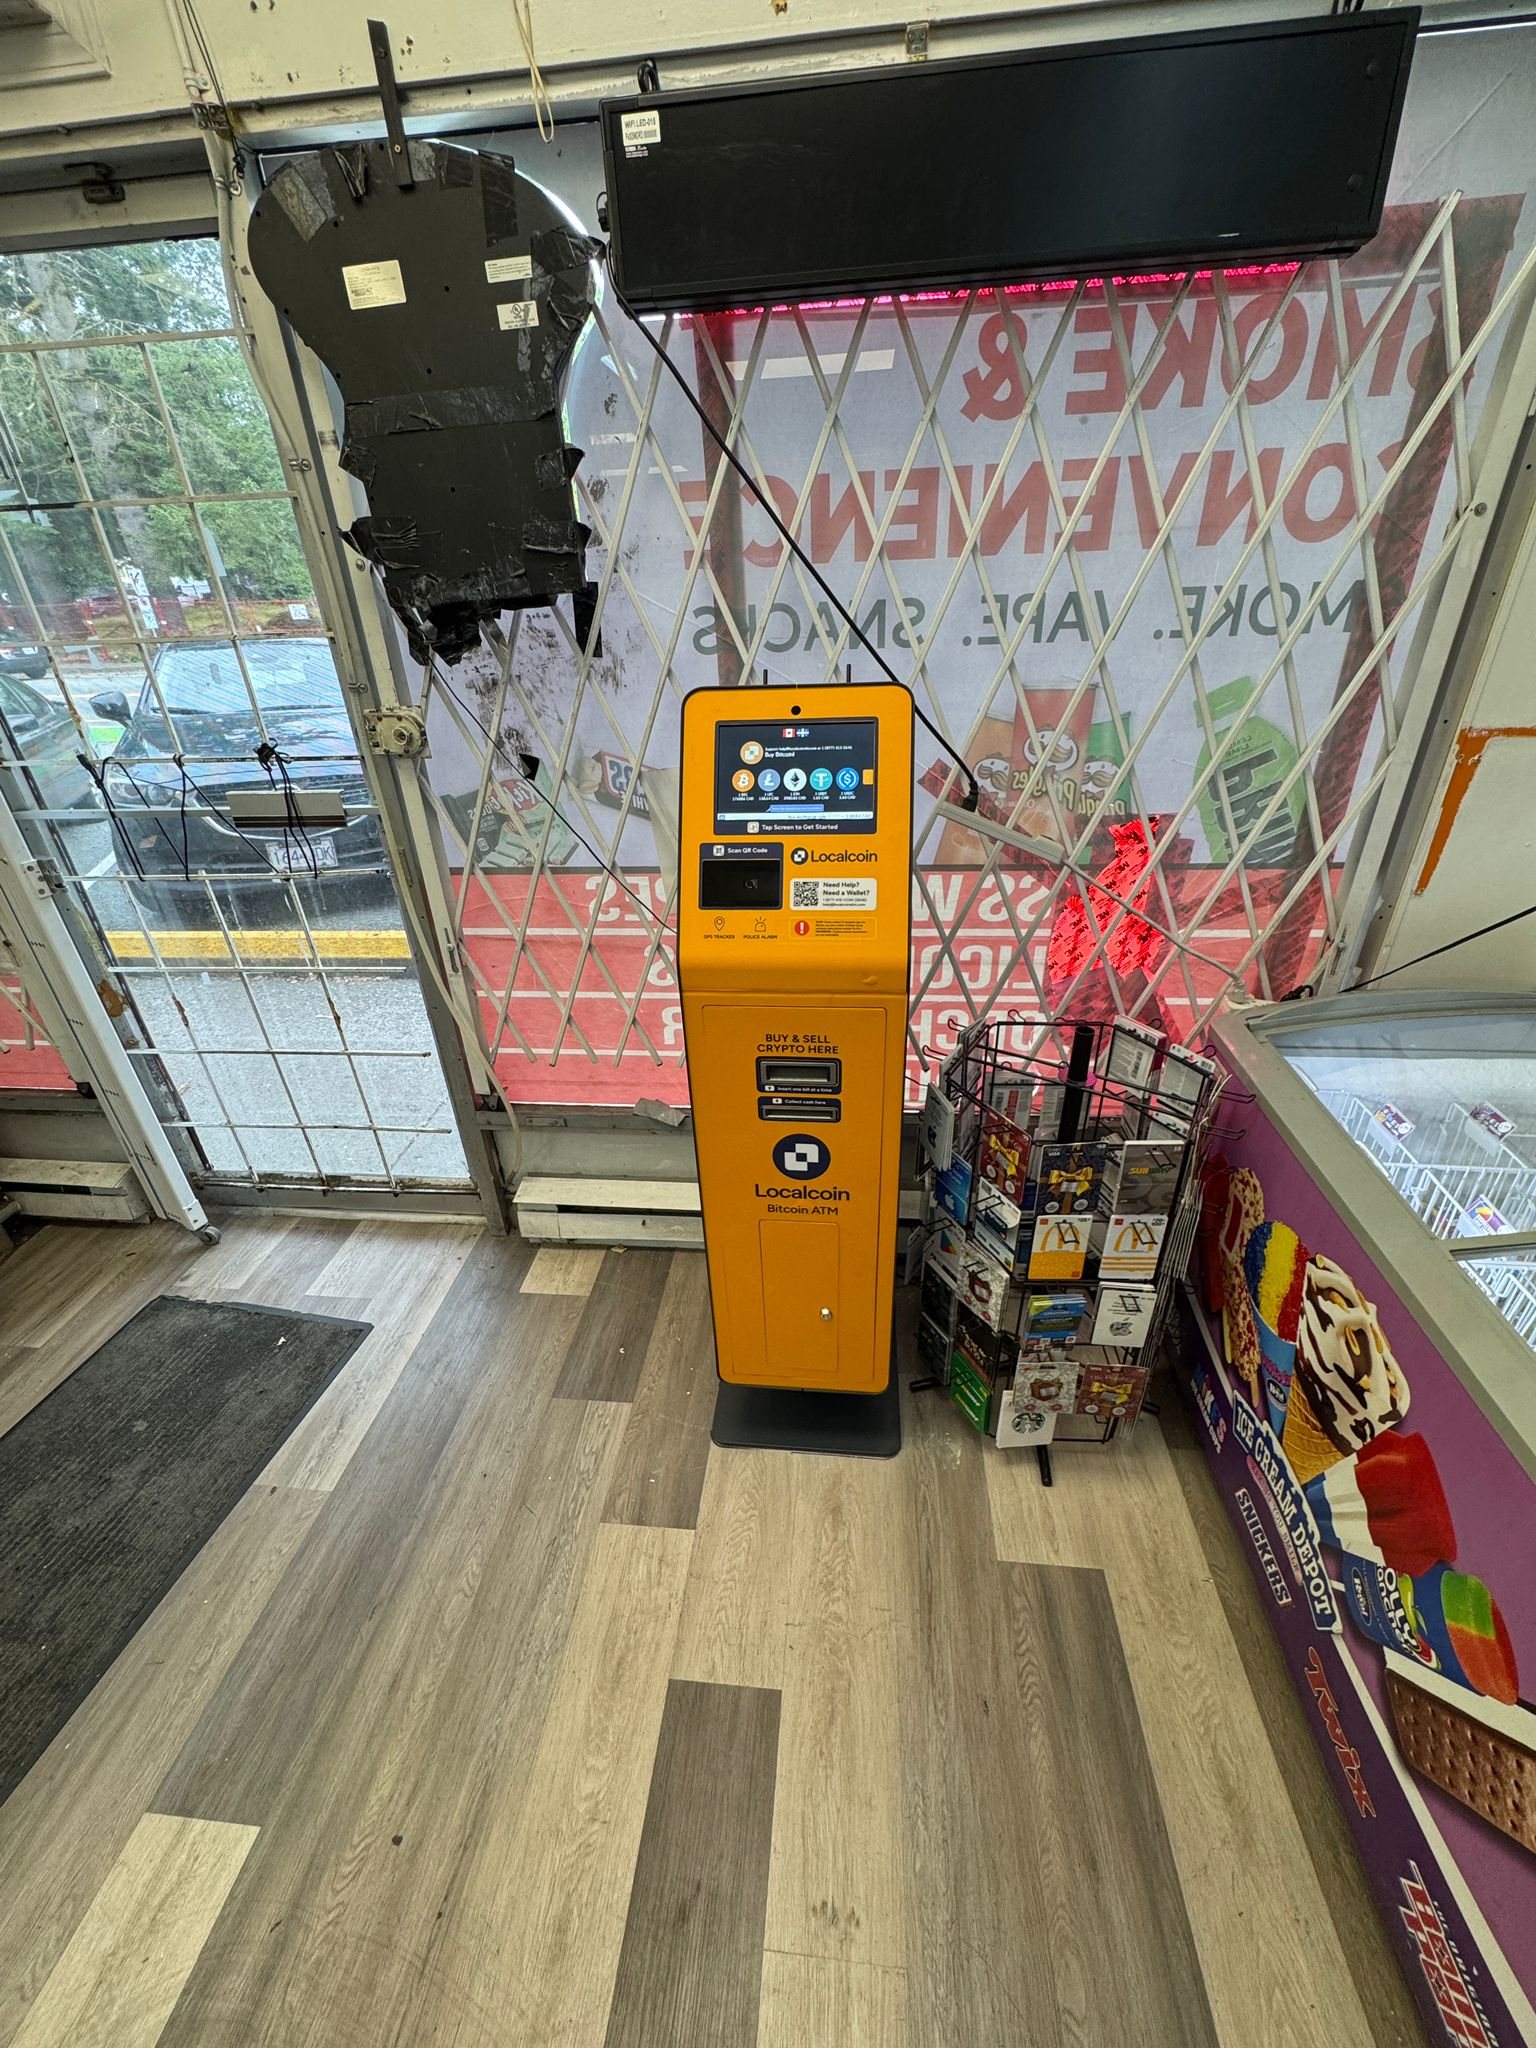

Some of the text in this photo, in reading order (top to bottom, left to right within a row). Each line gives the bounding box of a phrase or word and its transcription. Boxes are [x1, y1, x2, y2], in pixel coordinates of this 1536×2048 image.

[811, 850, 878, 863] Localcoin
[765, 1034, 831, 1044] BUY & SELL
[757, 1043, 839, 1054] CRYPTO HERE
[755, 1183, 850, 1202] Localcoin
[767, 1204, 839, 1216] Bitcoin ATM
[1236, 1411, 1254, 1449] ICE
[1254, 1434, 1298, 1526] CREAM
[1291, 1521, 1332, 1616] DEPOT
[1237, 1488, 1291, 1603] SNICKERS
[1384, 1567, 1423, 1652] OLLY
